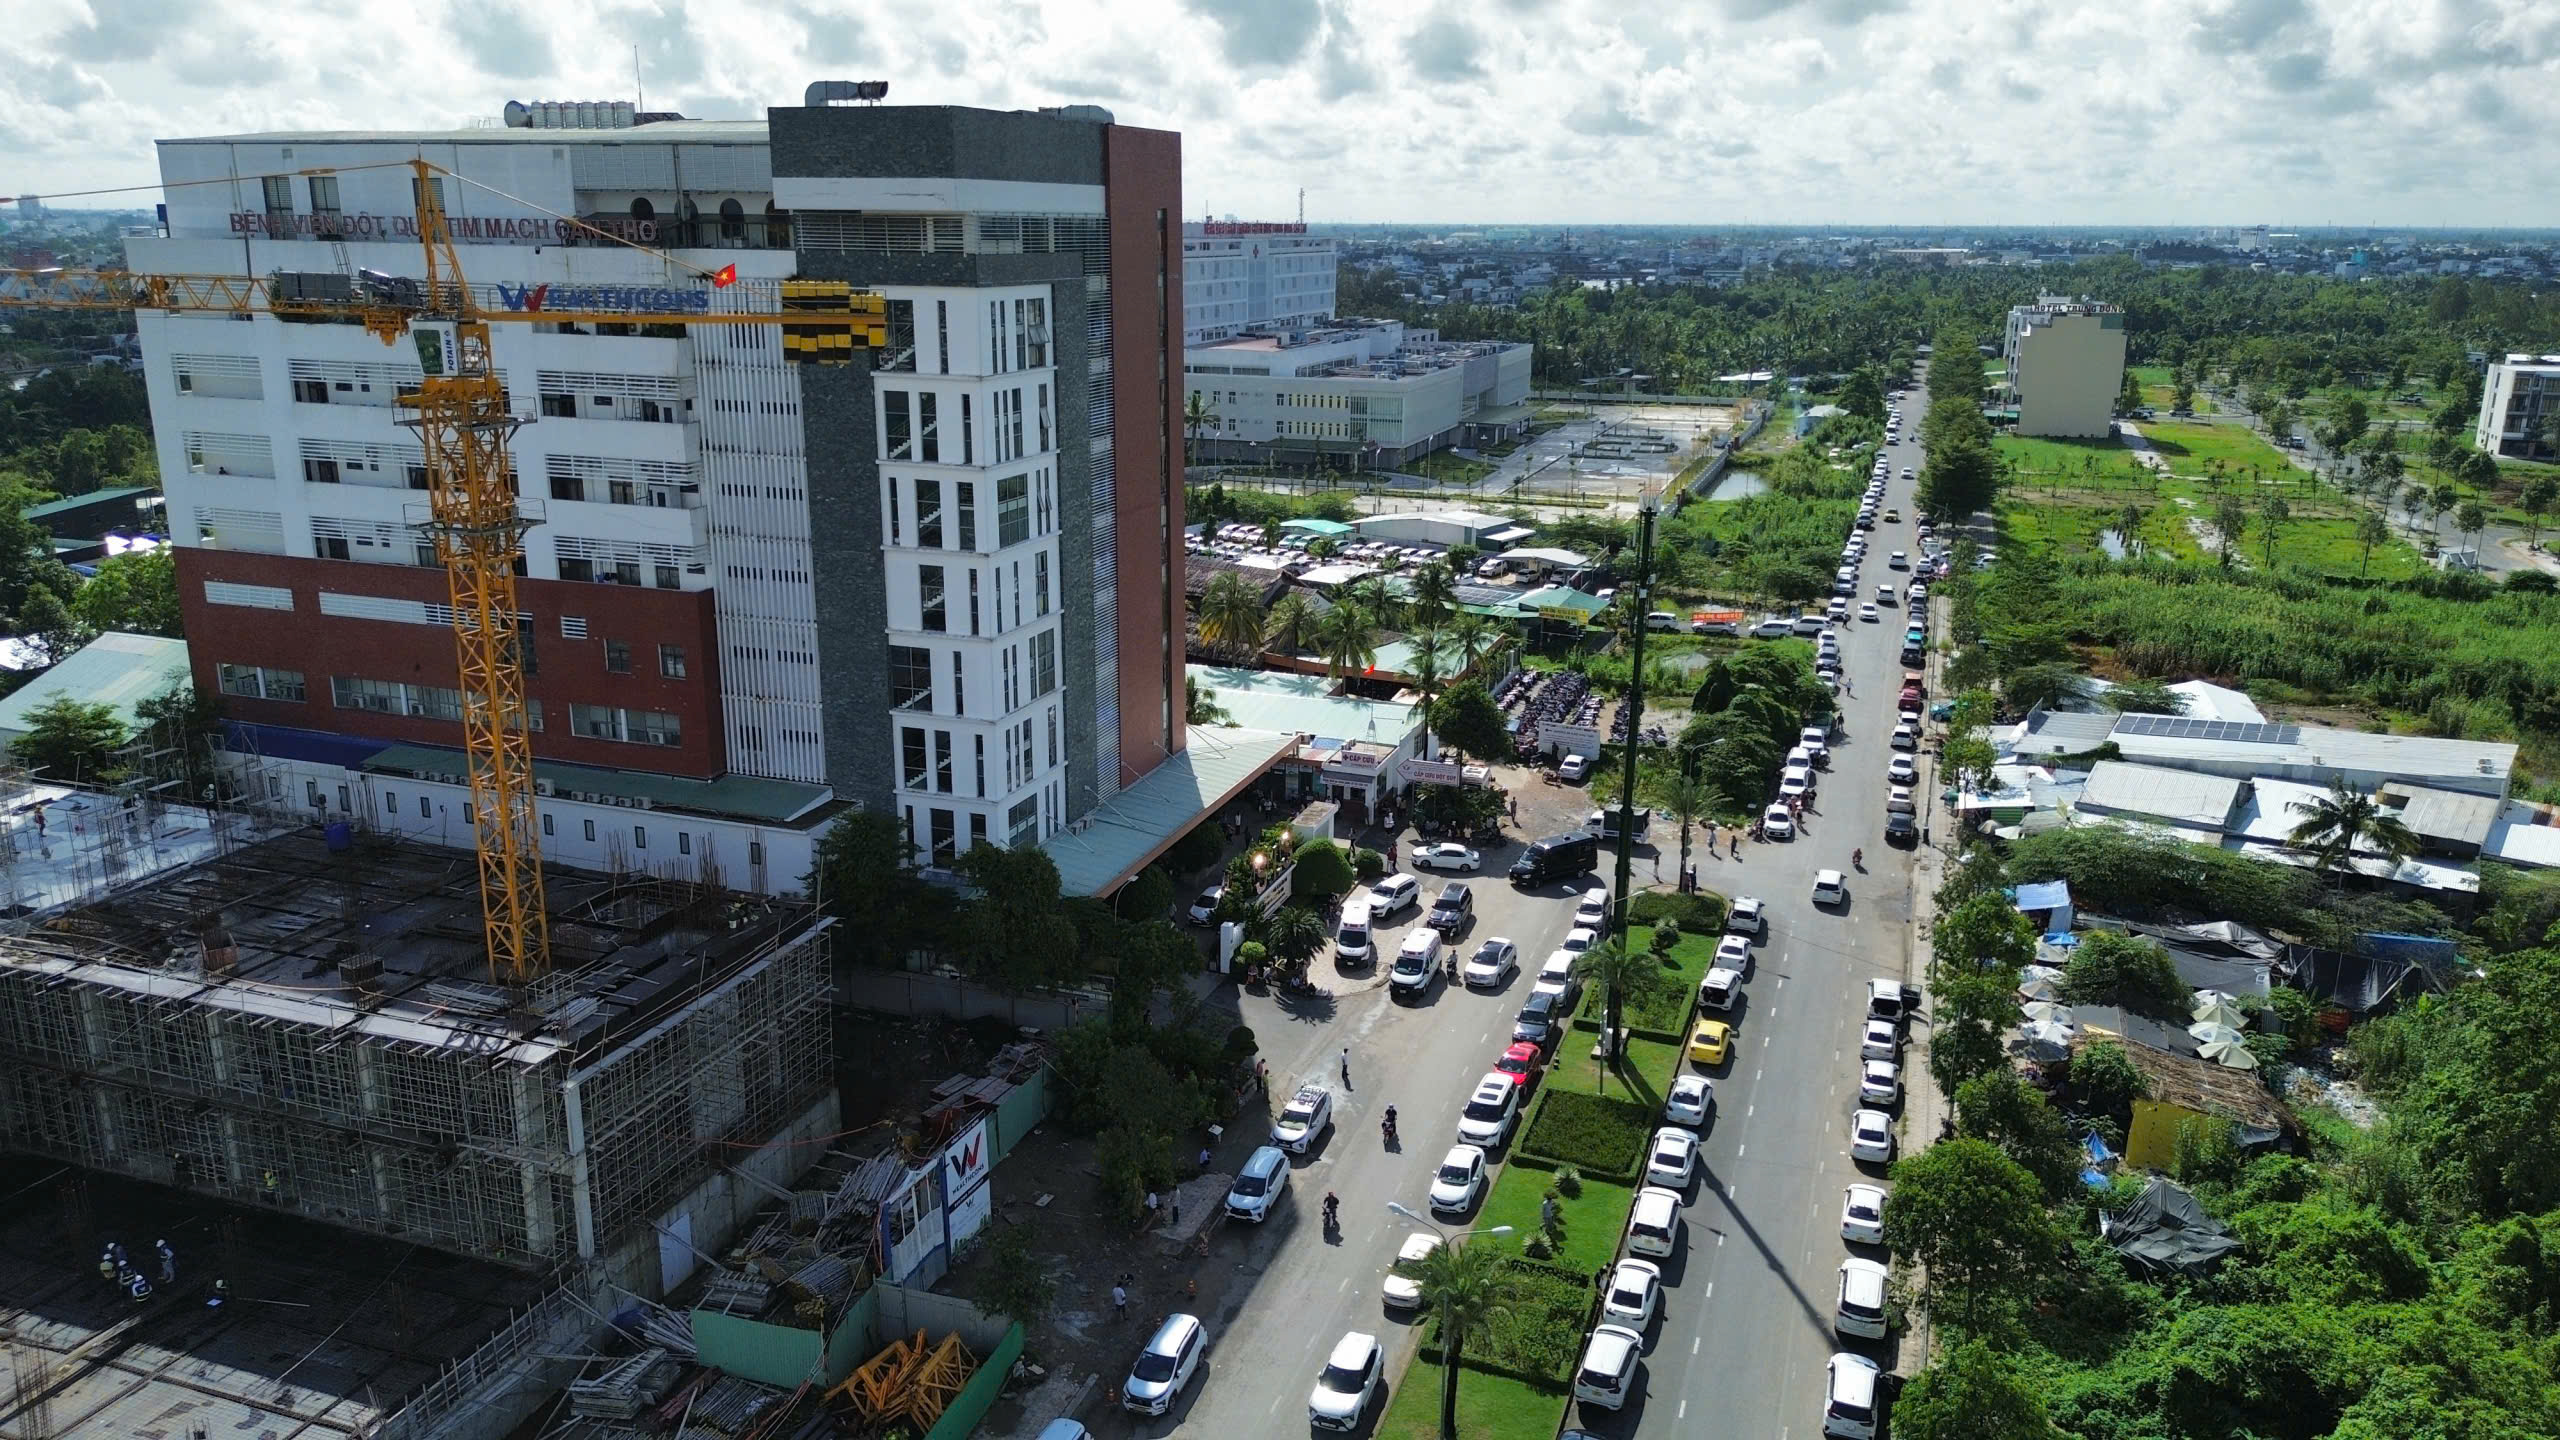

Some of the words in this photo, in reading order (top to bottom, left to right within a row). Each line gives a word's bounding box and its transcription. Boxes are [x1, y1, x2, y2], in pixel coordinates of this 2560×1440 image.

[444, 217, 482, 238] TIM
[2034, 304, 2063, 312] HOTEL
[445, 339, 455, 371] POTAIN
[952, 1162, 985, 1195] WEALTHCONS
